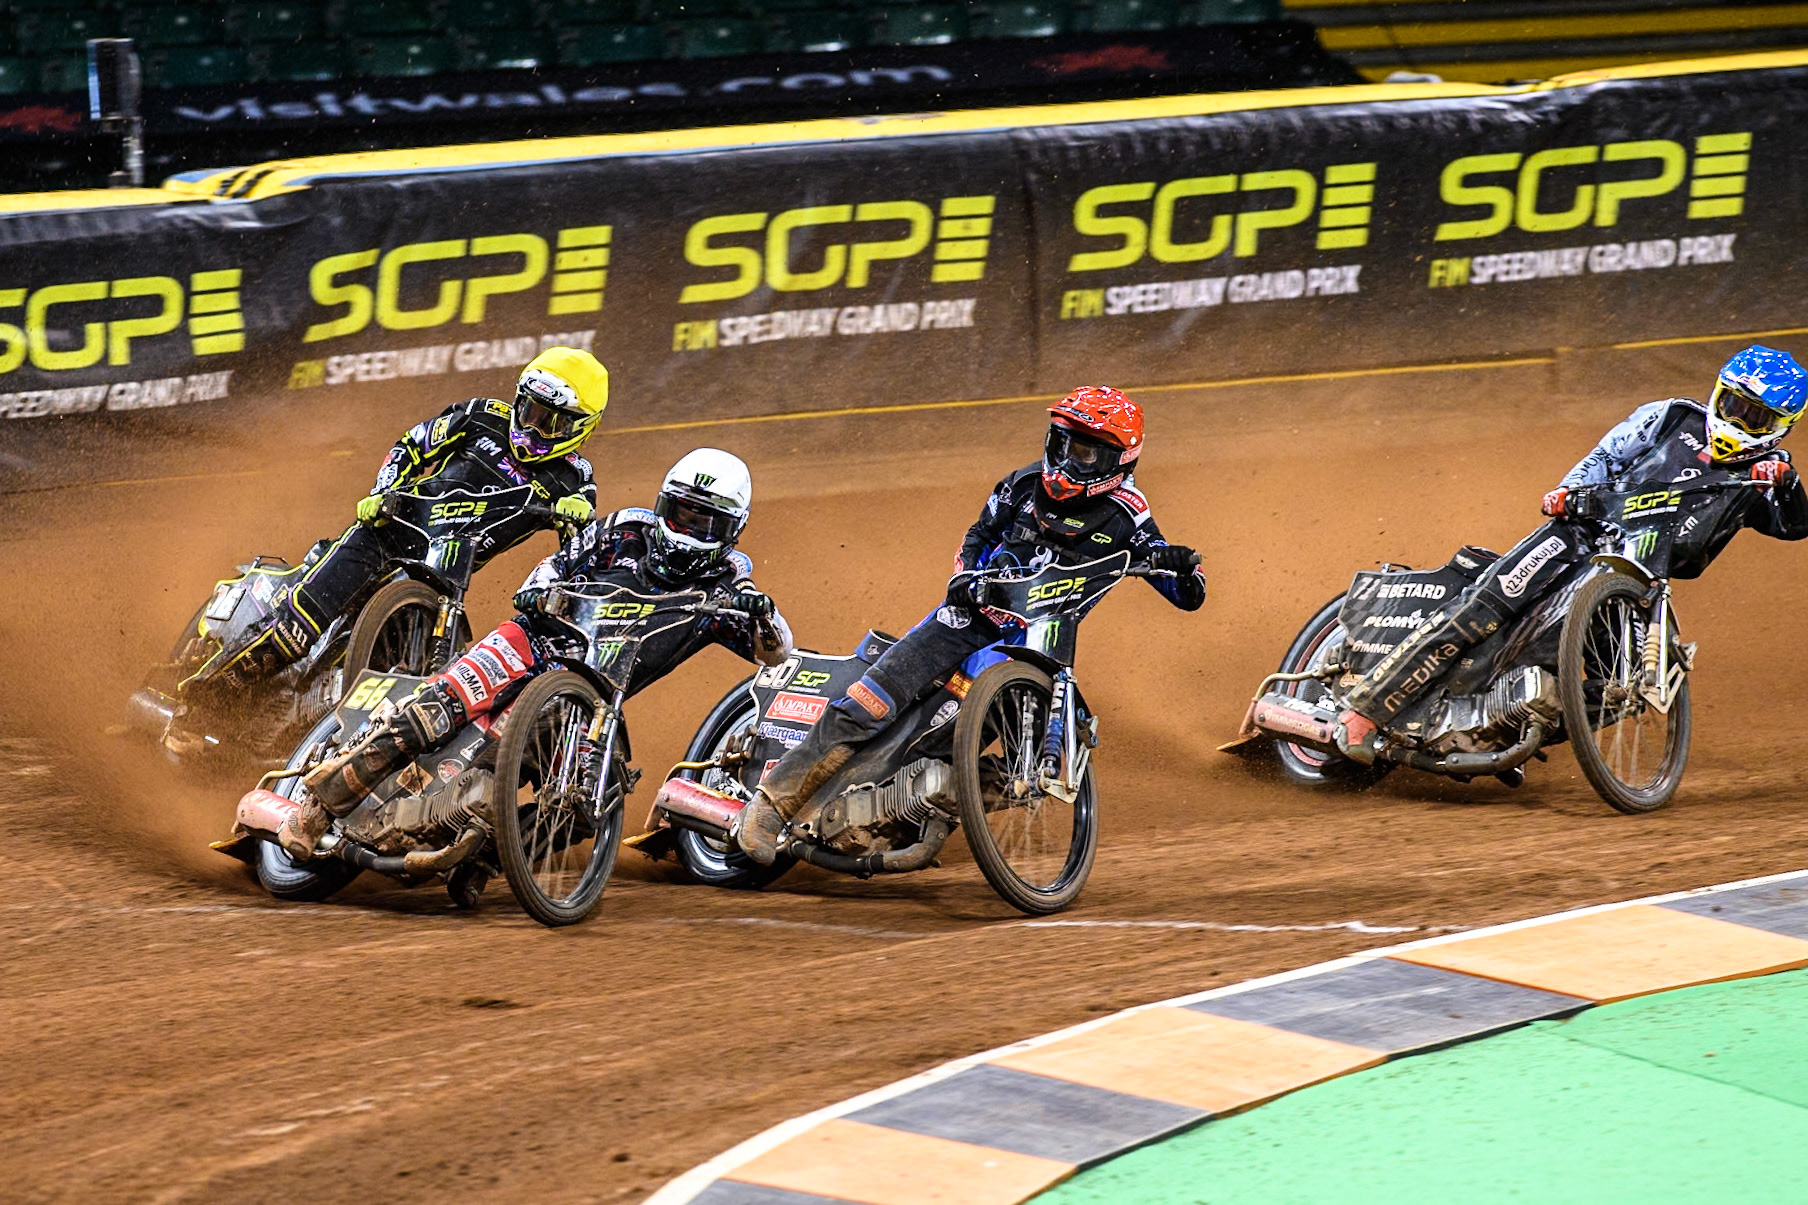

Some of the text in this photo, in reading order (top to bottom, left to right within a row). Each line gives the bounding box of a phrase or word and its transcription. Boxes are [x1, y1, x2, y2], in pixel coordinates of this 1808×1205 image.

[1470, 247, 1590, 285] SPEEDWAY
[1588, 239, 1677, 273] GRAND
[1677, 233, 1738, 266] PRIX
[1105, 277, 1228, 315] SPEEDWAY
[1227, 269, 1306, 304] GRAND
[1305, 264, 1363, 296] PRIX
[718, 307, 839, 347] SPEEDWAY
[837, 302, 920, 335] GRAND
[920, 298, 977, 330] PRIX
[326, 344, 456, 386] SPEEDWAY
[453, 336, 538, 372] GRAND
[106, 375, 185, 411] GRAND
[183, 369, 235, 404] PRIX
[1678, 431, 1704, 451] FIM
[1114, 489, 1144, 508] LOSTER
[1505, 540, 1563, 593] 123drukuj.pl
[1387, 583, 1447, 600] BETARD
[343, 676, 398, 711] 66
[782, 699, 823, 716] IMPAKT
